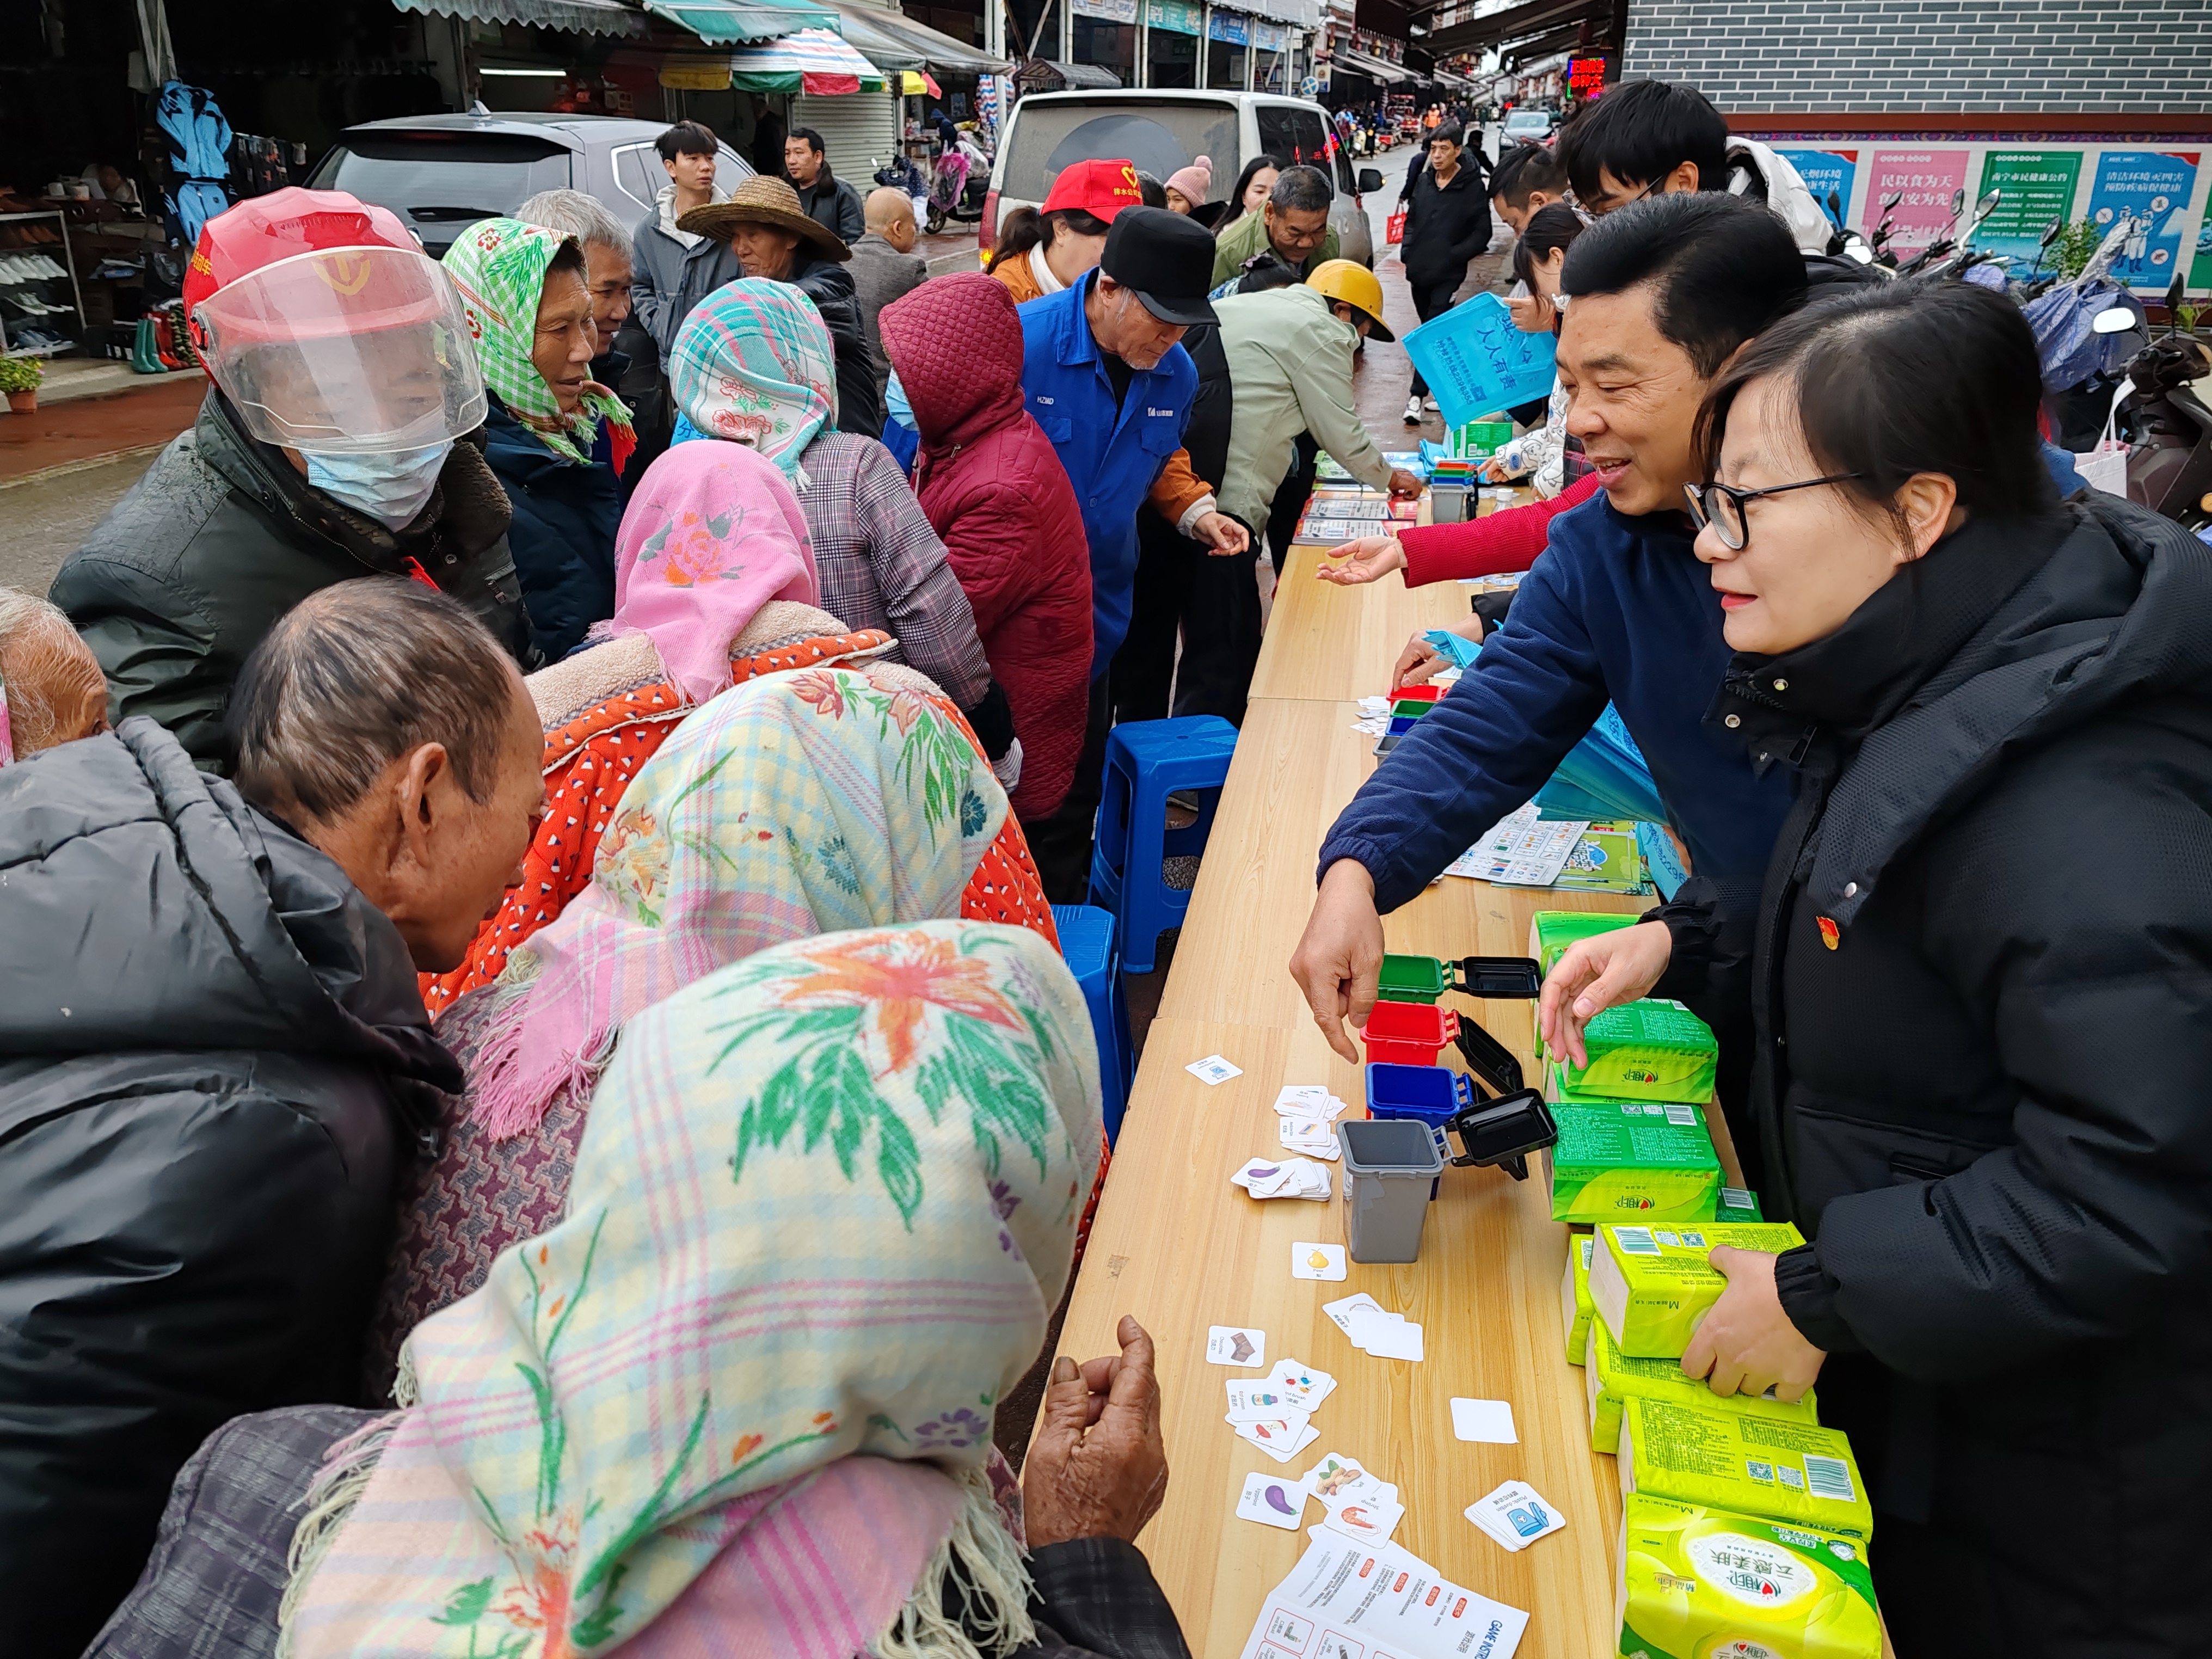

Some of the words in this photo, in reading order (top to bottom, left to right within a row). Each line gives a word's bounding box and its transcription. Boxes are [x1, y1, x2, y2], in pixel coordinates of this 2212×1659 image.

[1880, 174, 1953, 188] 民以食为天
[1878, 192, 1950, 206] 食安为先
[1477, 329, 1518, 390] 人人有责
[1669, 1300, 1679, 1310] M
[1361, 1500, 1380, 1510] Shrimp
[1496, 1502, 1513, 1511] dustbin
[1512, 1495, 1528, 1504] Plastic
[1680, 1506, 1693, 1515] M
[1709, 1550, 1794, 1580] 云感柔肤
[1726, 1571, 1781, 1599] 心相印
[1485, 1620, 1502, 1643] GAME
